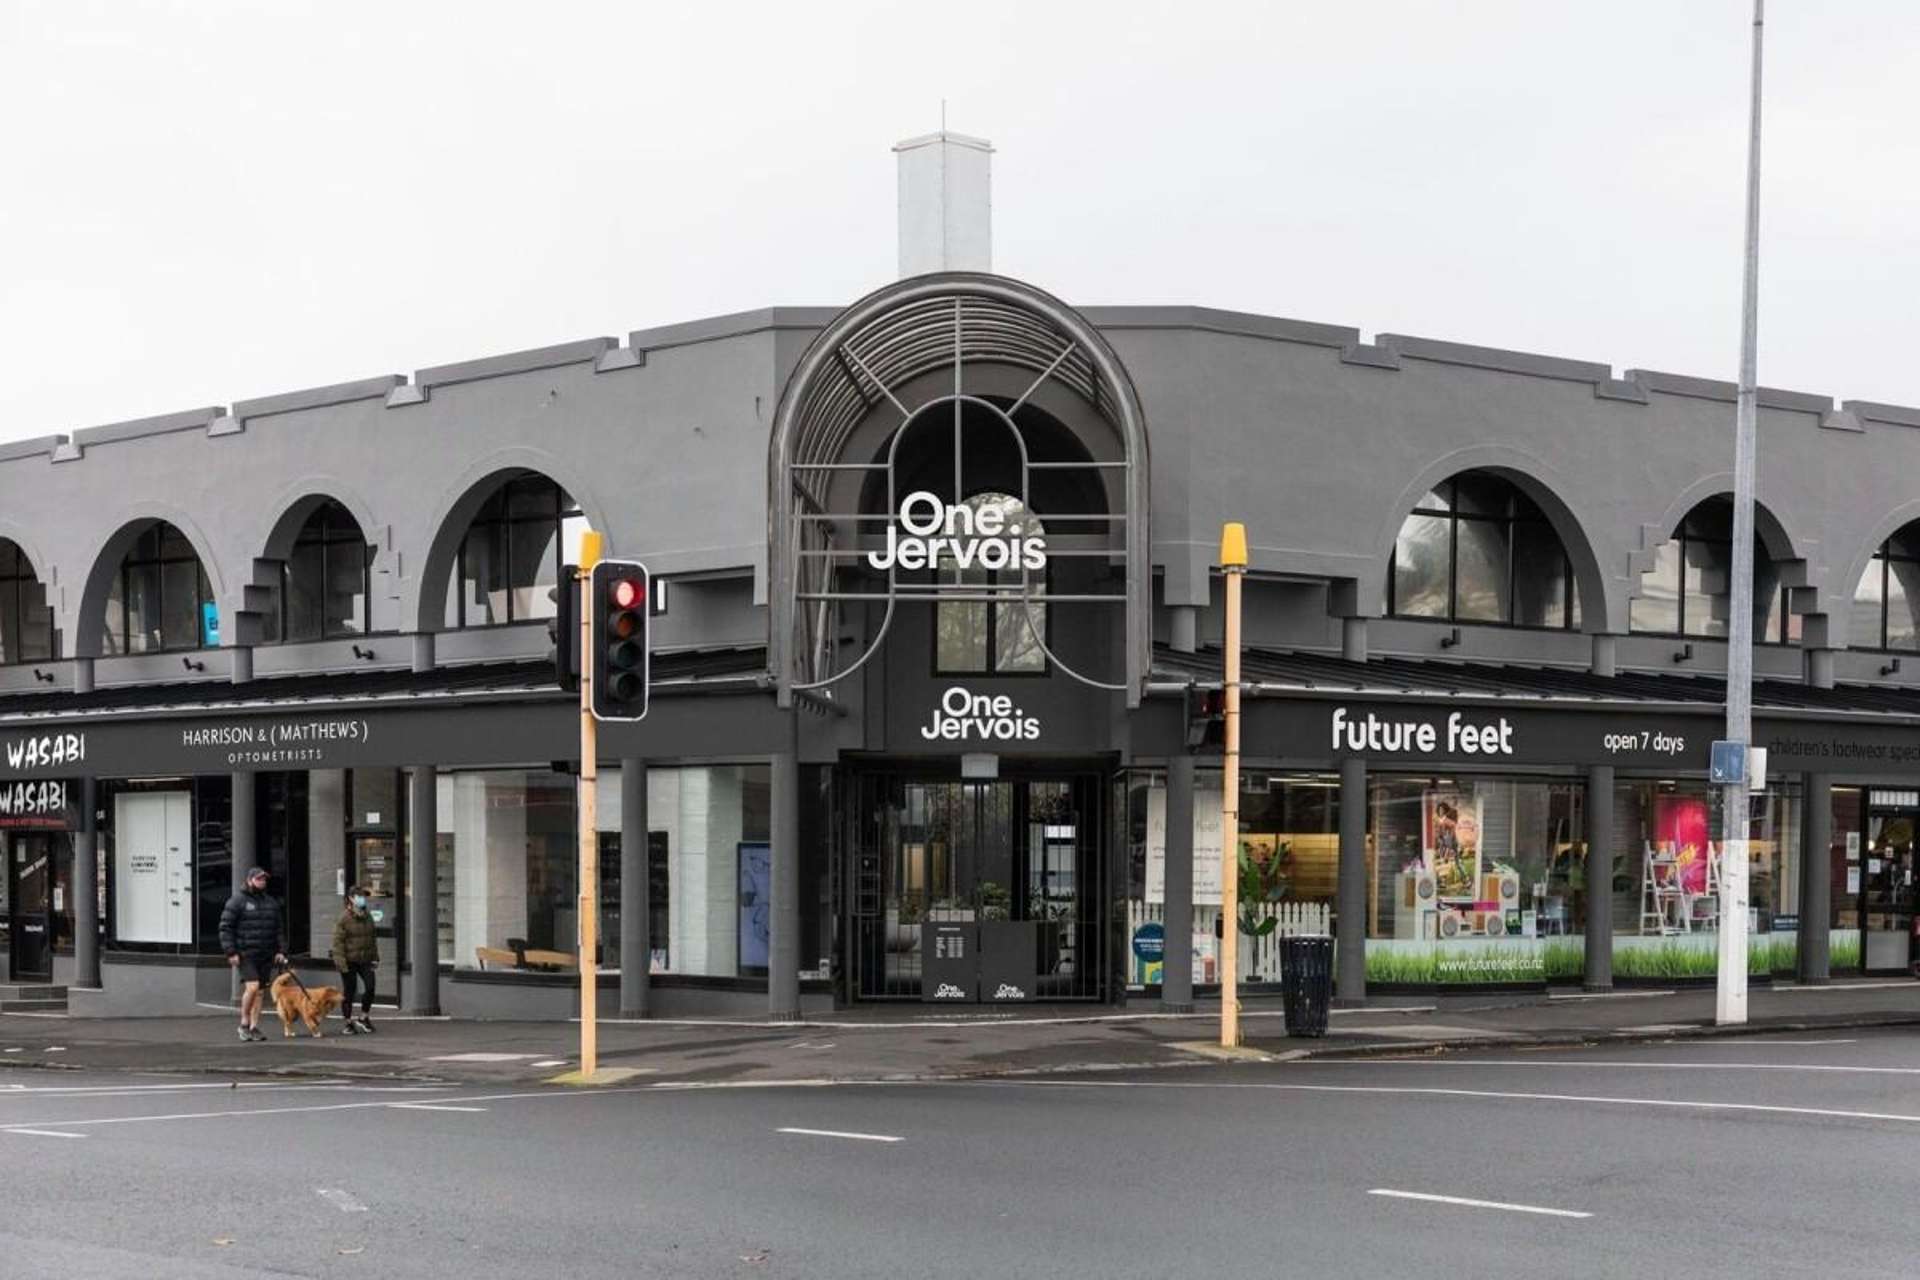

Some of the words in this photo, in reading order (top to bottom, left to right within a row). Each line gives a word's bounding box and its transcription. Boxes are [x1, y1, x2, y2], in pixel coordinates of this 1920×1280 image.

[900, 491, 1005, 537] One
[868, 525, 1047, 571] Jervois
[942, 687, 1013, 718] One
[183, 727, 254, 746] HARRISON
[257, 729, 267, 742] &
[921, 709, 1040, 740] Jervois
[1333, 708, 1437, 752] future
[1448, 713, 1513, 755] feet
[6, 733, 86, 769] WASABI
[228, 748, 322, 765] OPTOMETRISTS
[1604, 734, 1638, 754] open
[1641, 732, 1650, 750] 7
[1653, 731, 1685, 756] days
[1832, 739, 1886, 759] footwear
[0, 781, 66, 815] WASABI
